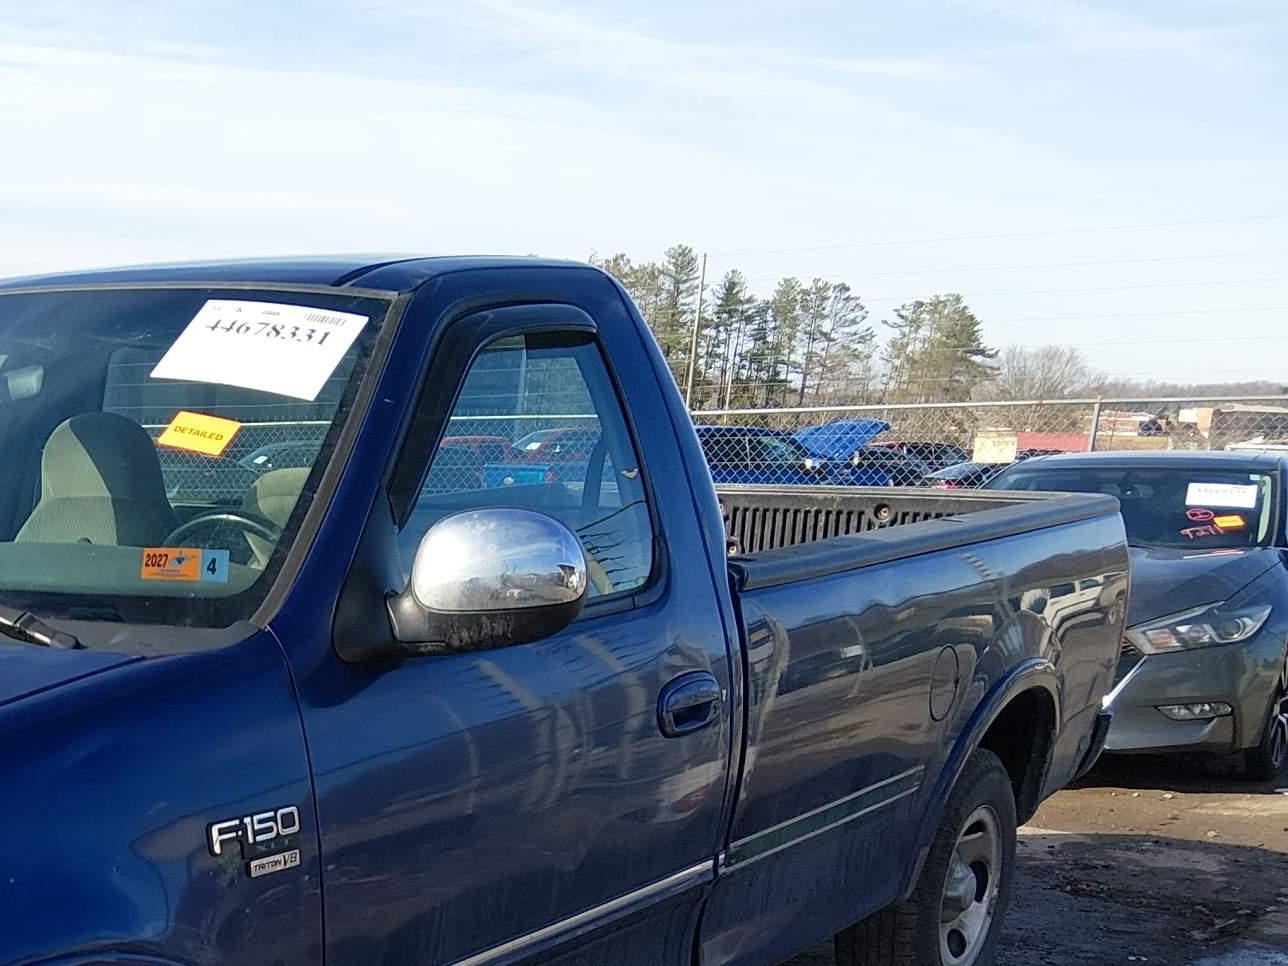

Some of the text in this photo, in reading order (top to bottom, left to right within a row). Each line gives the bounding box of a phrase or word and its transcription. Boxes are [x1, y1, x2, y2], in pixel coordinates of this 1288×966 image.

[205, 315, 331, 346] 44678331
[173, 425, 224, 441] DETAILED
[144, 553, 217, 575] 2027 4
[253, 852, 298, 873] TRITON V8
